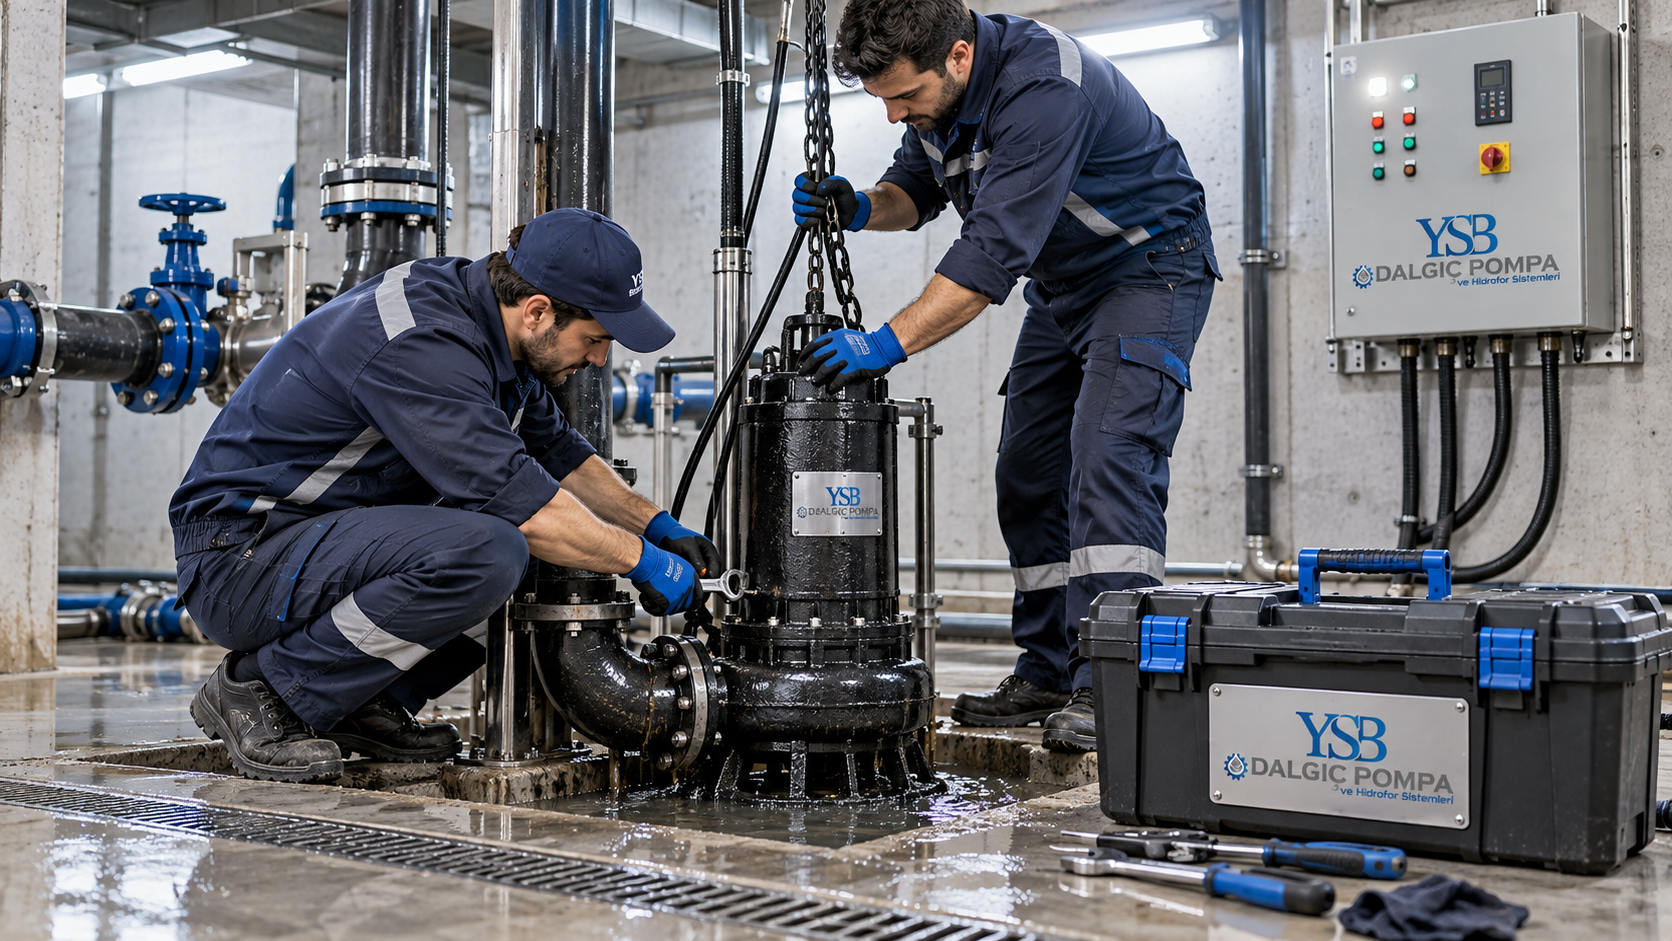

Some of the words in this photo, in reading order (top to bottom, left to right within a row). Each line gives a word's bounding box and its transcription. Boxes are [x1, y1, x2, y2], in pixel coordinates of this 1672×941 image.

[1416, 214, 1498, 258] YSB
[1469, 254, 1560, 276] POMPA
[1457, 279, 1469, 287] ve
[1471, 276, 1510, 286] Hidrofor
[1512, 271, 1561, 284] Sistemleri
[825, 486, 862, 507] YSB
[1295, 711, 1388, 763] YSB
[1354, 766, 1454, 794] POMPA
[1340, 787, 1353, 796] ve
[1356, 787, 1399, 800] Hidrofor
[1401, 791, 1454, 805] Sistemleri
